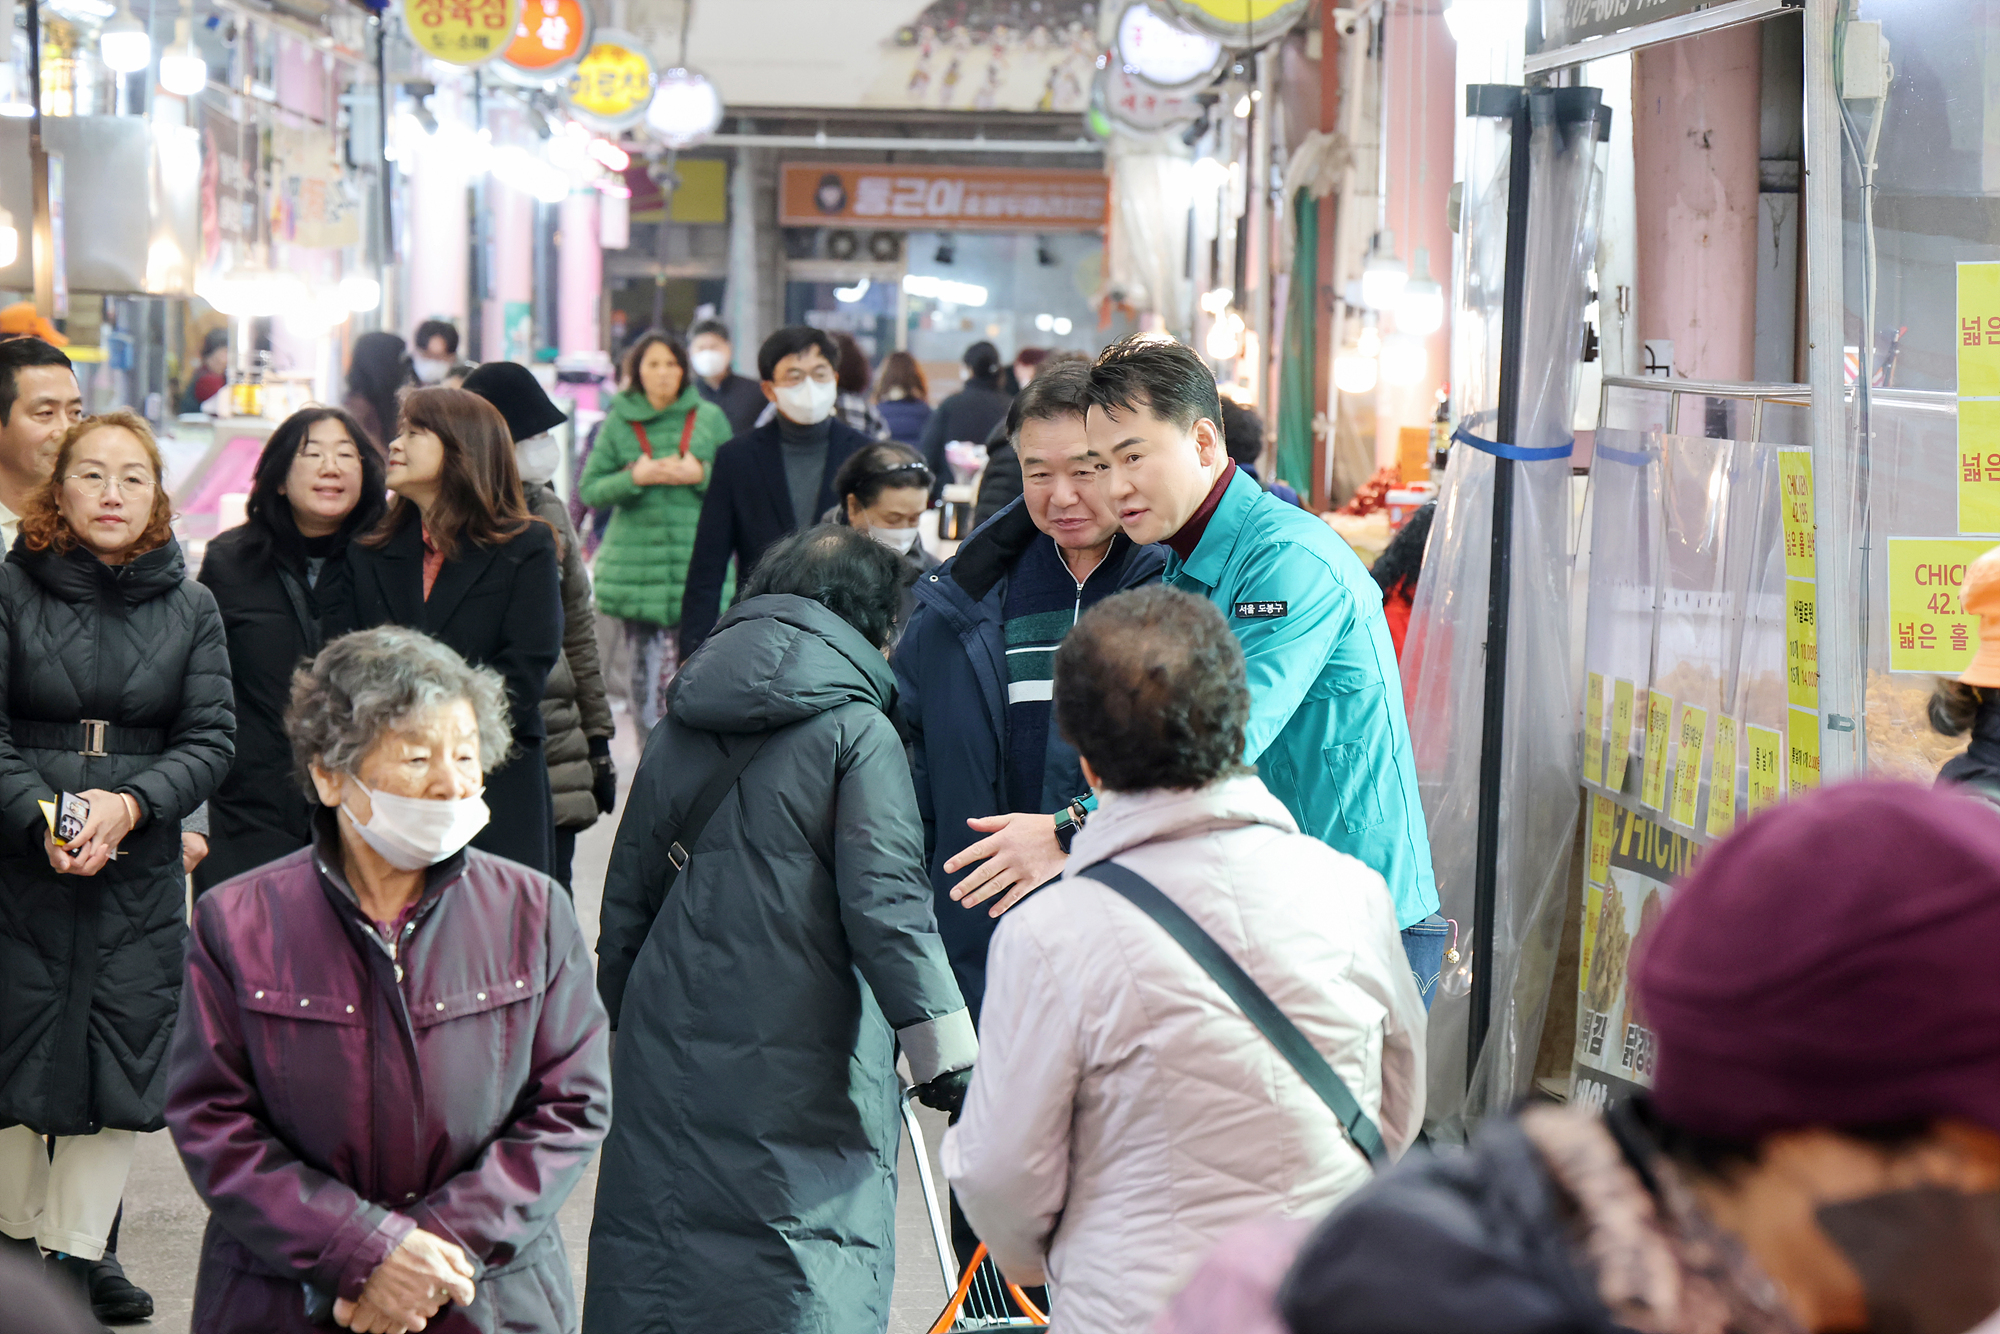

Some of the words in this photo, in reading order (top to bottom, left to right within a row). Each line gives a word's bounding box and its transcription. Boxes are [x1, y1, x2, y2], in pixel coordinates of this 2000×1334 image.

[1962, 316, 2000, 346] 넓은
[1962, 453, 2000, 482] 넓은
[1786, 474, 1809, 496] CHICKEN
[1792, 502, 1808, 523] 42.195
[1785, 530, 1797, 557] 넓은
[1799, 530, 1805, 558] 홀
[1238, 603, 1256, 616] 서울
[1257, 602, 1284, 615] 도봉구
[1898, 621, 1937, 650] 넓은
[1949, 622, 1969, 651] 홀
